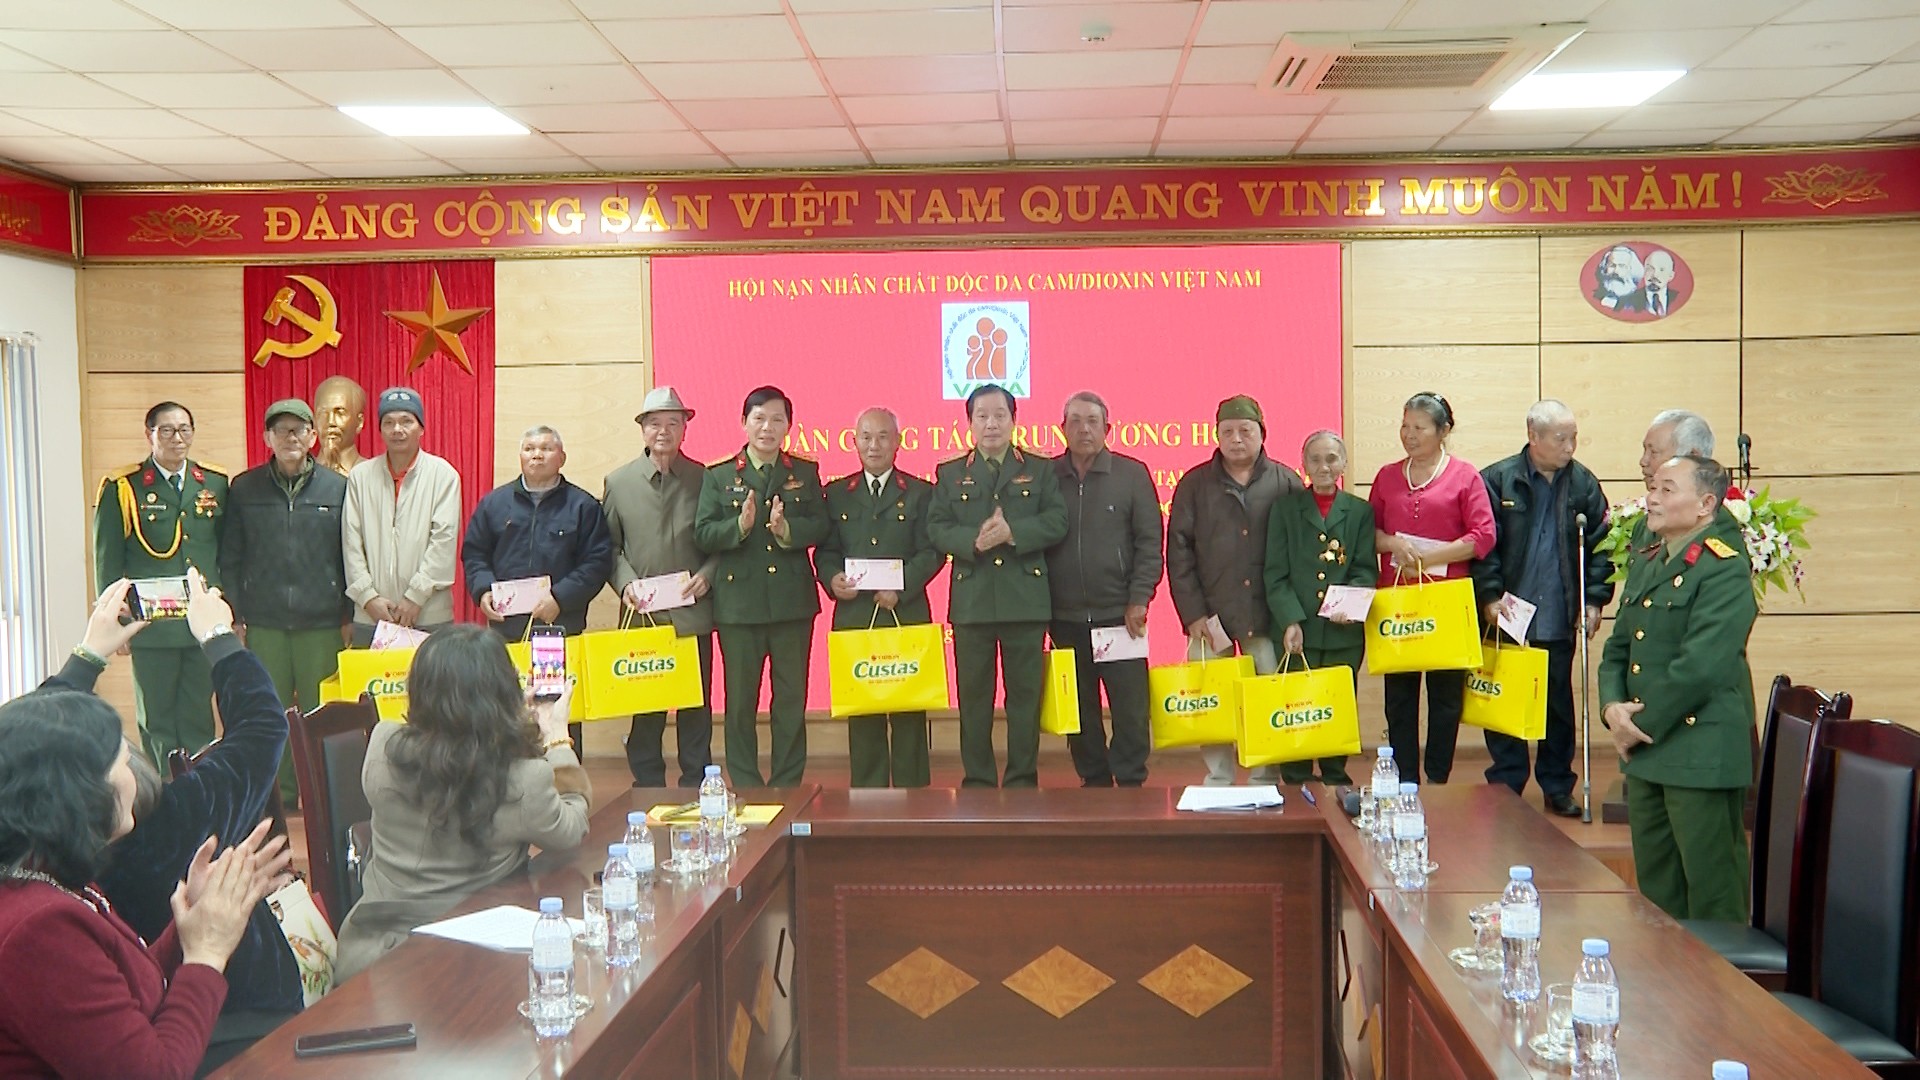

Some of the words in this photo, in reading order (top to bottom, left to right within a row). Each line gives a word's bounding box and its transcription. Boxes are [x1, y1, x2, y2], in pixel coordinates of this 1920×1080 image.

[263, 193, 419, 242] ĐẢNG
[434, 189, 586, 244] CỘNG
[600, 183, 712, 233] SẢN
[729, 181, 859, 237] VIỆT
[875, 187, 1006, 225] NAM
[1020, 181, 1223, 224] QUANG
[1238, 178, 1386, 217] VINH
[1399, 166, 1569, 216] MUÔN
[772, 278, 813, 300] NẠN
[820, 272, 876, 296] NHÂN
[994, 273, 1023, 292] DA
[1027, 271, 1155, 292] CAM/DIOXIN
[1160, 268, 1209, 293] VIỆT
[1215, 268, 1262, 289] NAM
[838, 426, 918, 453] CG
[1379, 618, 1436, 637] Custas
[613, 657, 675, 677] Custas
[854, 661, 919, 679] Custas
[367, 679, 406, 697] Cus
[1164, 695, 1219, 714] Custas
[1271, 706, 1333, 729] Custas
